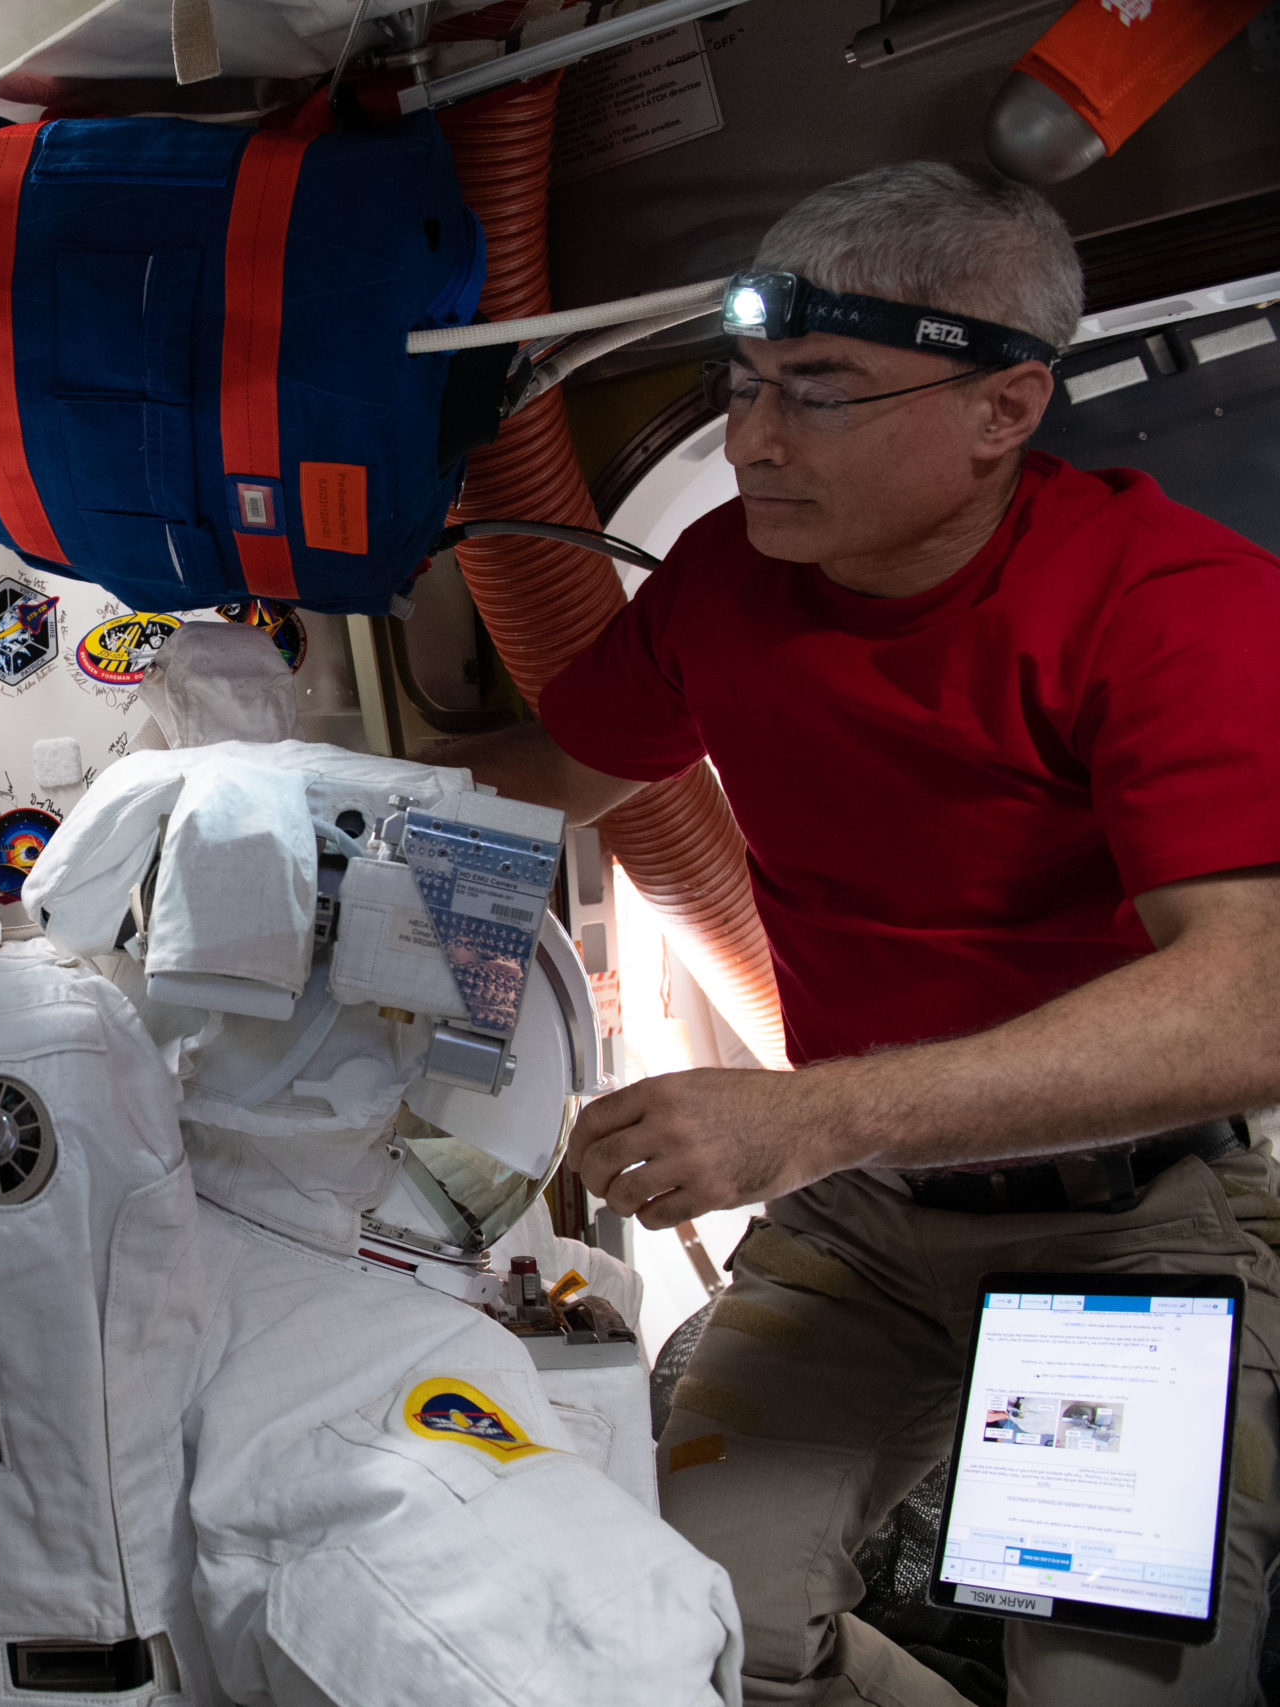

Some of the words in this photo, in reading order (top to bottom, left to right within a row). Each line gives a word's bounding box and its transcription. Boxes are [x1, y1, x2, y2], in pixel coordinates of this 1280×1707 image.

[656, 29, 678, 42] down.
[638, 63, 662, 78] VALVE
[616, 82, 645, 98] position.
[646, 80, 678, 97] position.
[616, 106, 632, 117] Turn
[641, 92, 667, 107] LATCH
[669, 81, 701, 97] direction
[651, 119, 682, 134] position.
[916, 319, 970, 346] PETZL
[20, 587, 39, 600] VIRTS
[26, 604, 48, 622] STS-130
[20, 657, 47, 677] PATRICK
[80, 651, 98, 675] BEHNKEN
[101, 672, 131, 681] FOREMAN
[460, 871, 471, 879] HD
[472, 874, 489, 883] EMU
[490, 878, 518, 890] Camera
[970, 1590, 996, 1605] MSL
[999, 1594, 1036, 1611] MARK
